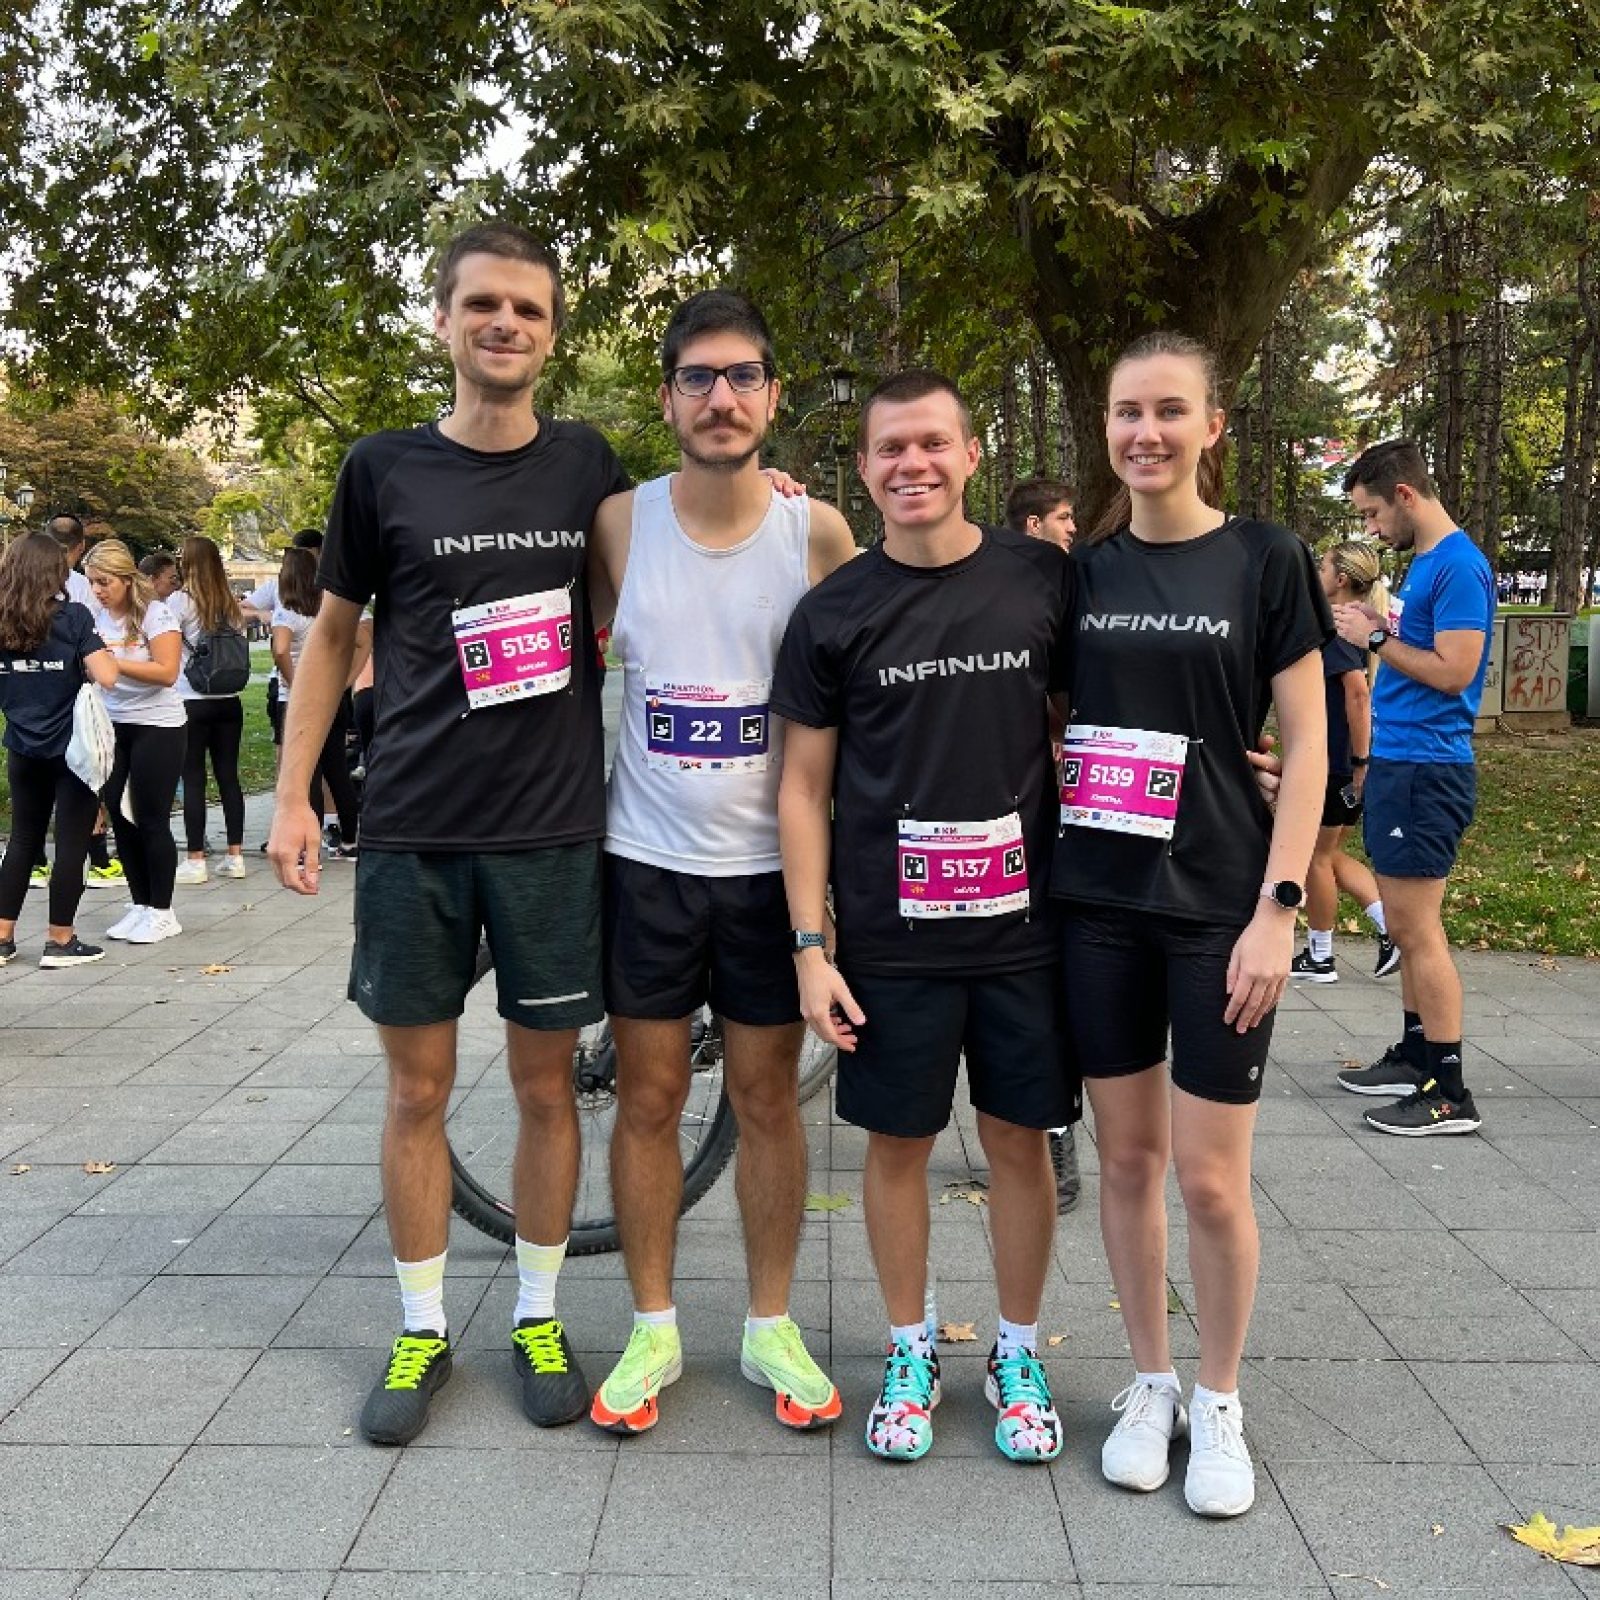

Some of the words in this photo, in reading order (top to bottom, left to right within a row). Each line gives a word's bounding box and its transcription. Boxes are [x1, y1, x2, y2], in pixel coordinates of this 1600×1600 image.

[433, 530, 585, 556] INFINUM
[501, 631, 552, 659] 5136
[878, 649, 1030, 686] INFINUM
[663, 682, 715, 694] MARATHON
[689, 720, 722, 742] 22
[1088, 764, 1135, 787] 5139
[941, 857, 992, 878] 5137
